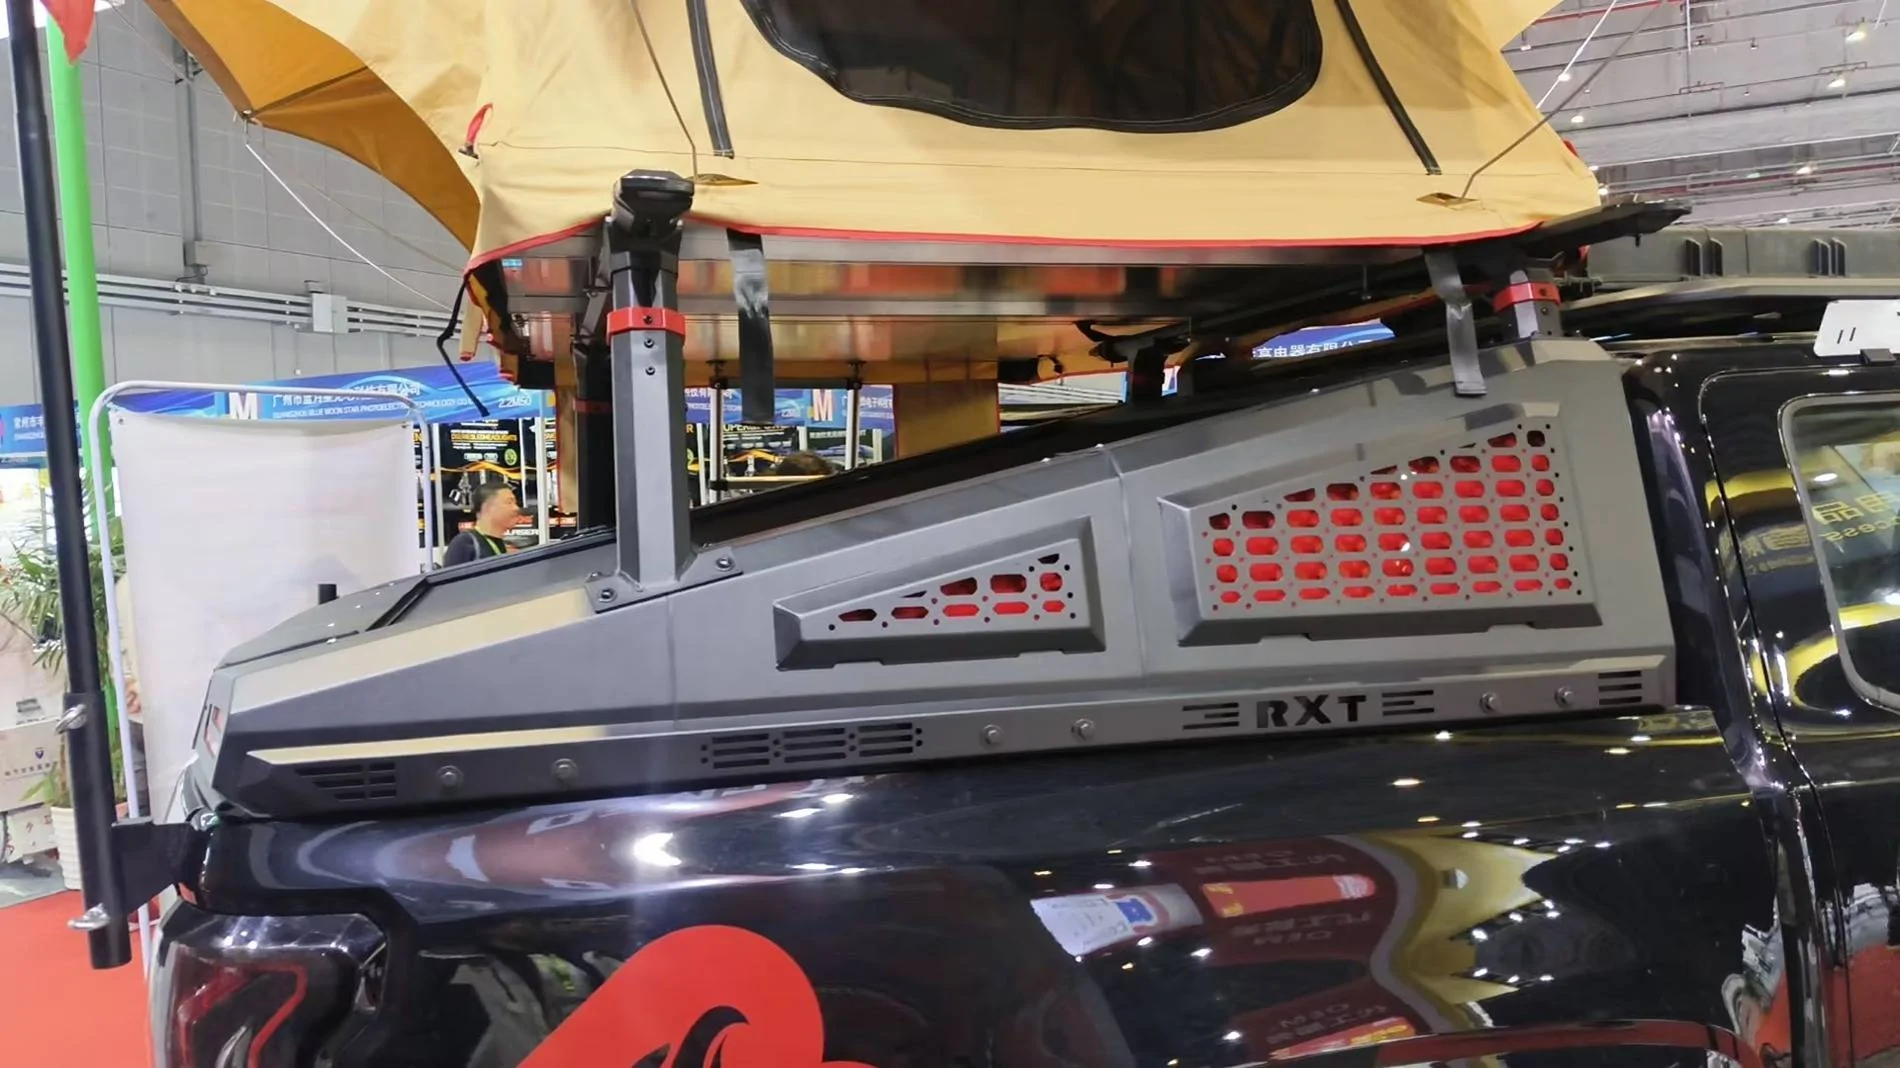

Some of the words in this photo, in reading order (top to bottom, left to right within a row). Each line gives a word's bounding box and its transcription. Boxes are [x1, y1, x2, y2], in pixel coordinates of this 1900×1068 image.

[228, 392, 257, 420] M
[812, 389, 833, 421] M
[1256, 694, 1367, 729] RXT
